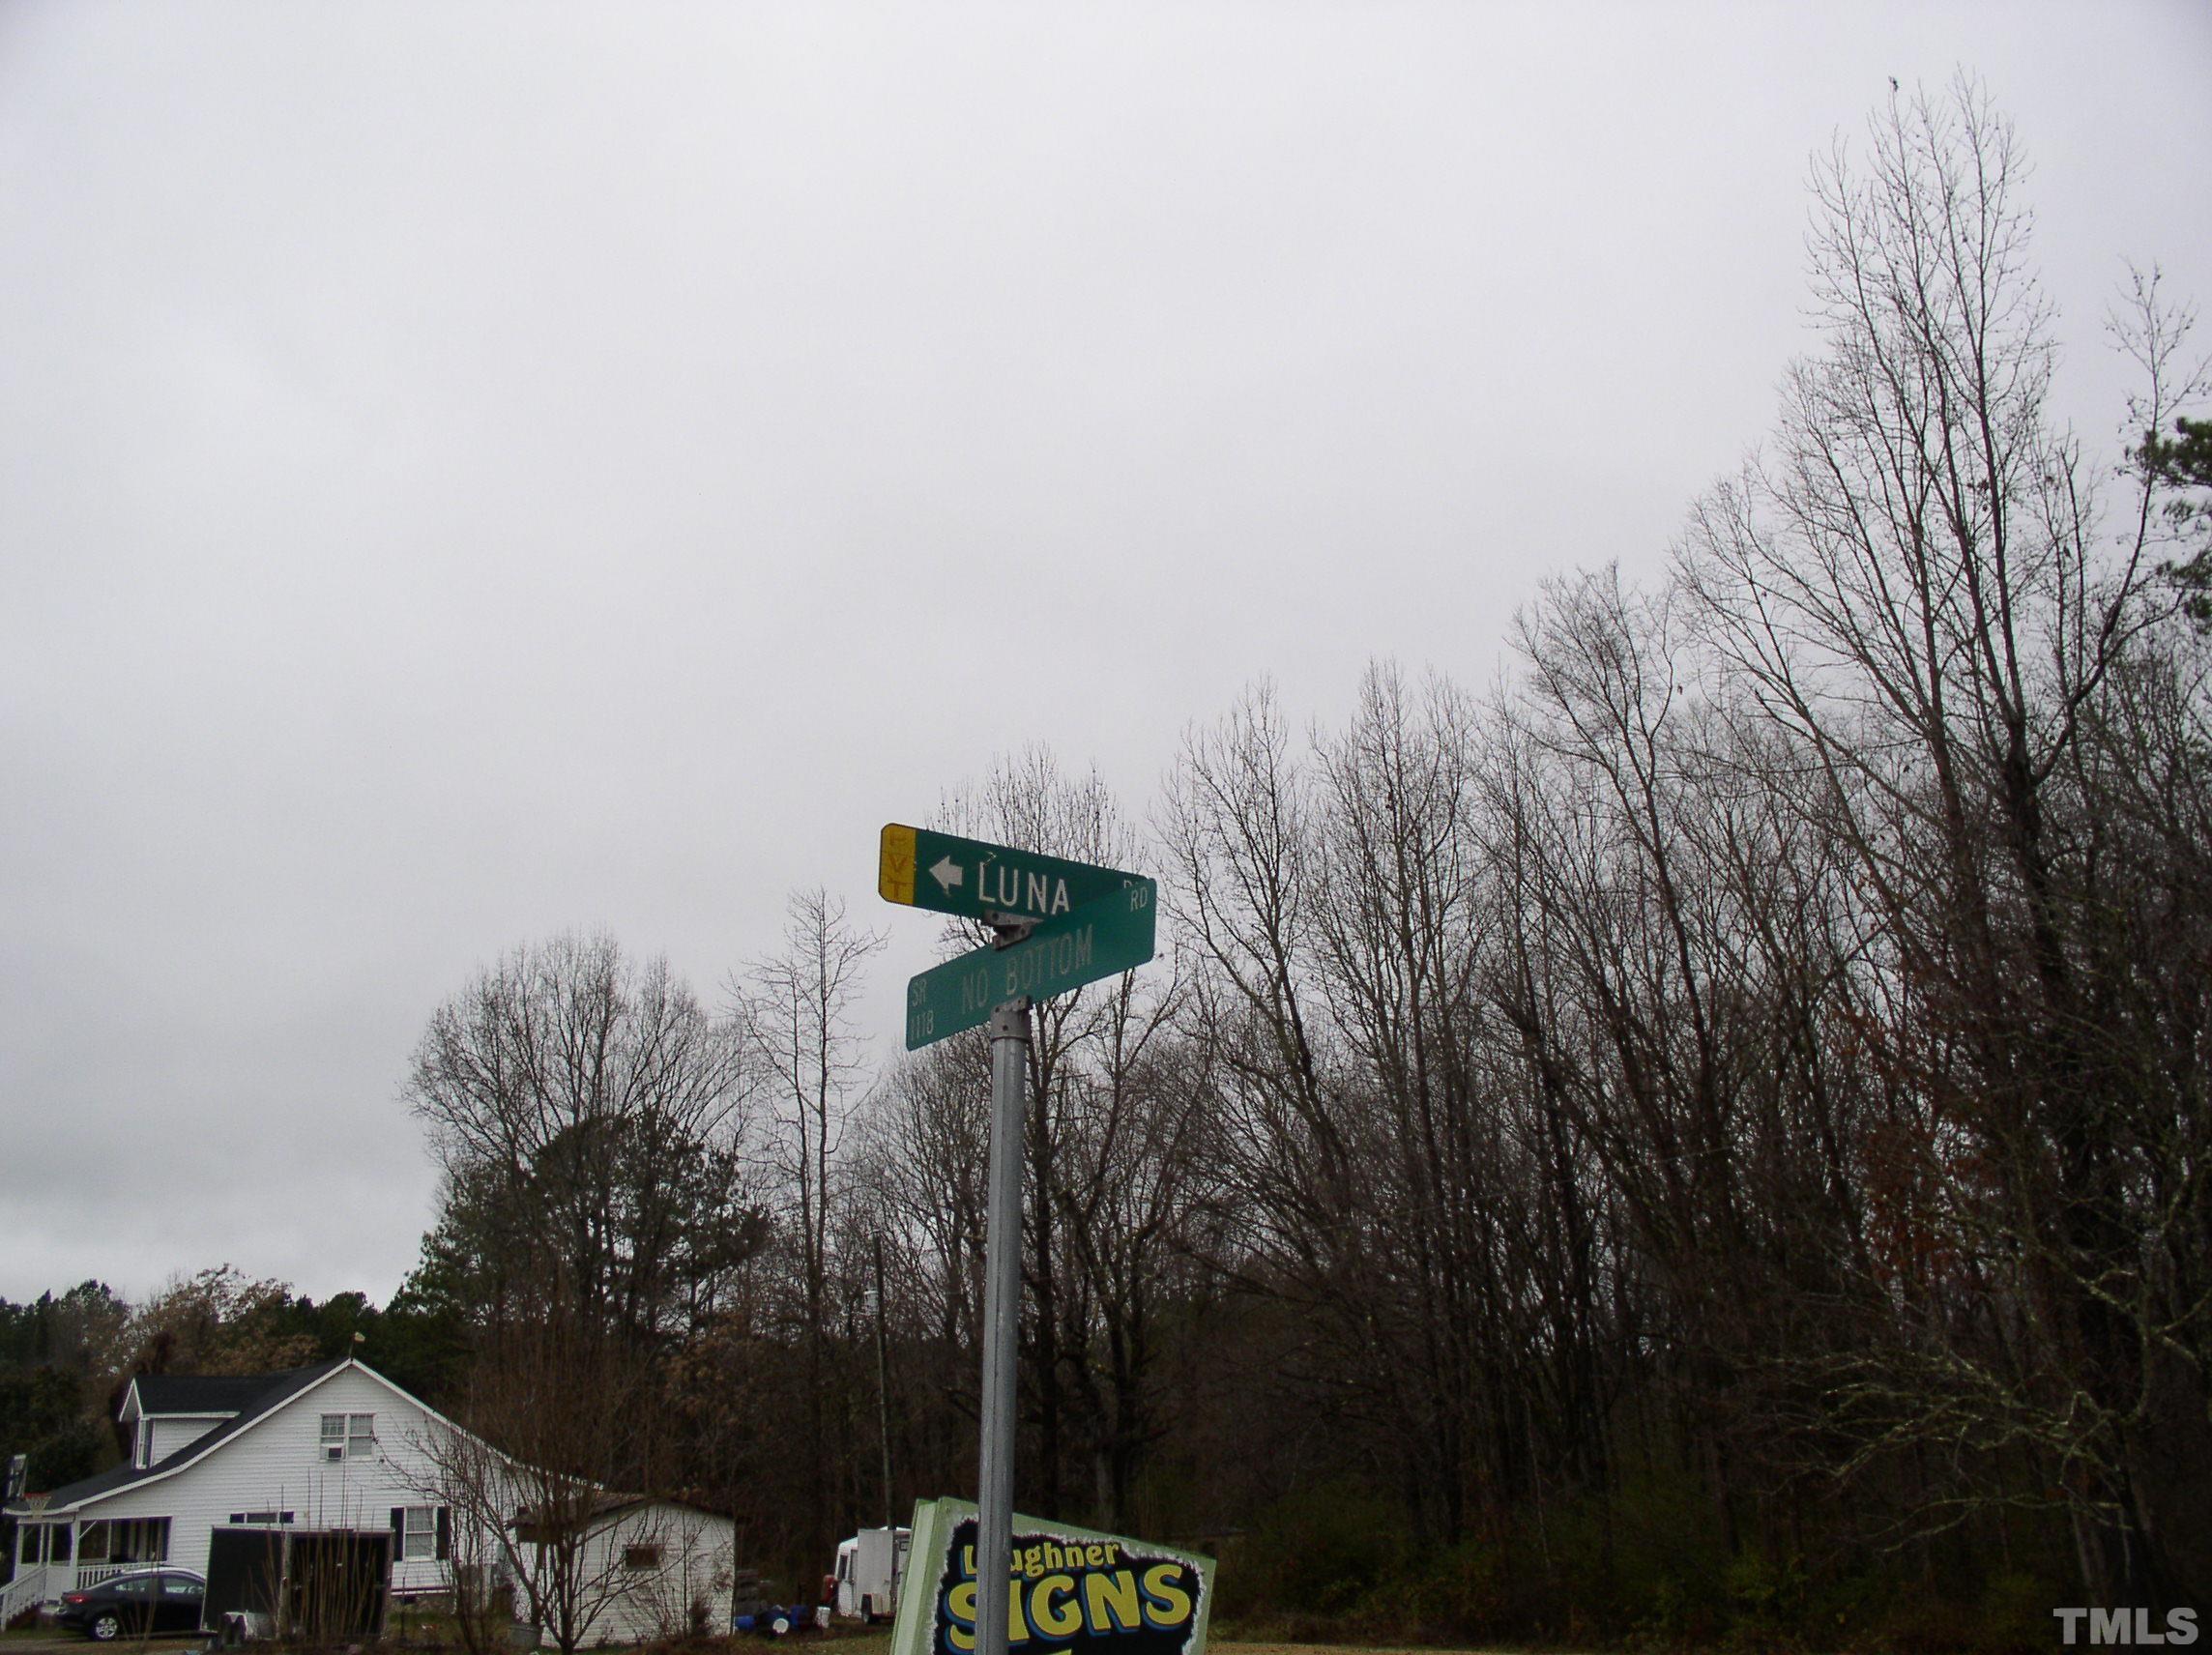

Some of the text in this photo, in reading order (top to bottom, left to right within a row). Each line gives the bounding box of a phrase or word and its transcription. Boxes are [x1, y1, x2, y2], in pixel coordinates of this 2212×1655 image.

[977, 860, 1069, 915] LUNA
[1130, 886, 1148, 912] RD
[961, 923, 1093, 1014] NO BOTTOM
[912, 978, 927, 1006] SR
[963, 1542, 1120, 1578] Lughner
